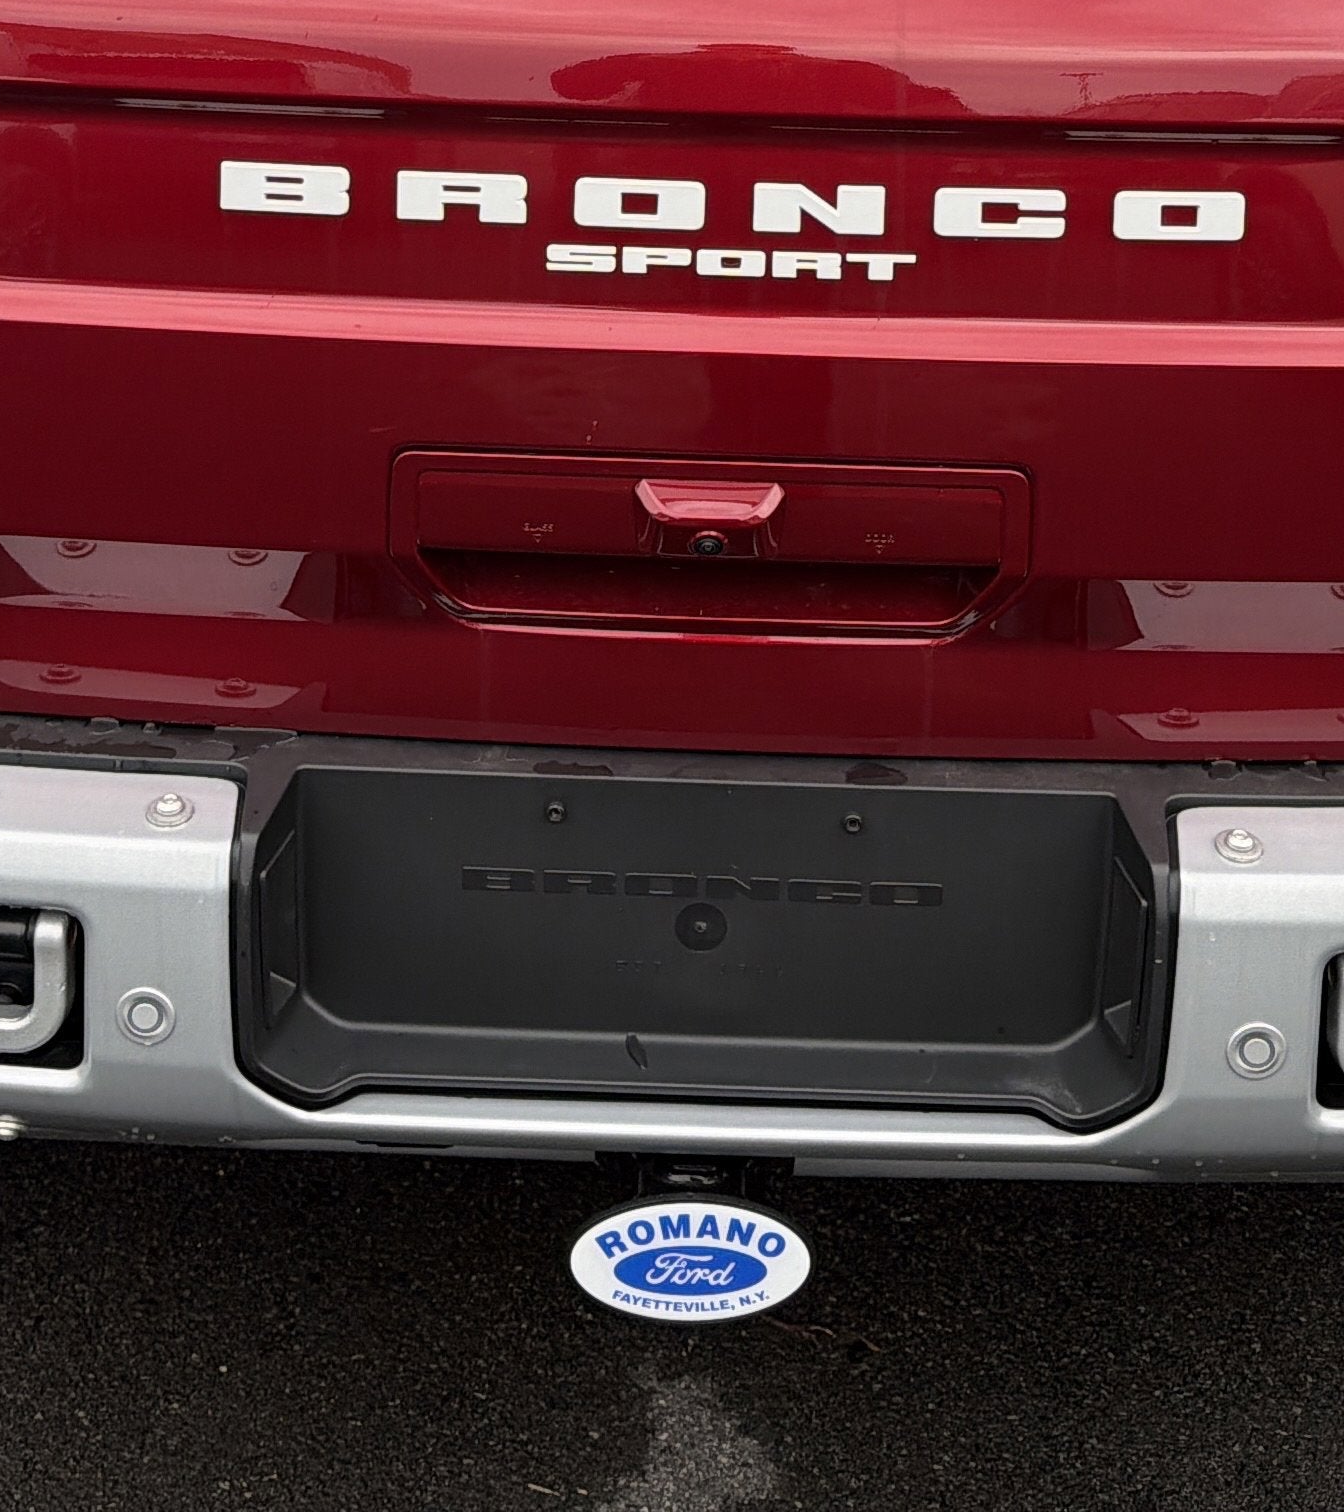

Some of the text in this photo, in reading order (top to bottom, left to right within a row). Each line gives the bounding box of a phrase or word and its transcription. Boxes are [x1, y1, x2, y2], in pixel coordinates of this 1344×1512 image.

[220, 160, 1246, 241] BRONCO
[546, 243, 917, 281] SPORT
[461, 866, 944, 906] BRONCO
[594, 1213, 787, 1259] ROMANO
[646, 1252, 737, 1286] Ford
[612, 1290, 770, 1313] FAYETTEVILLE, N.Y.
